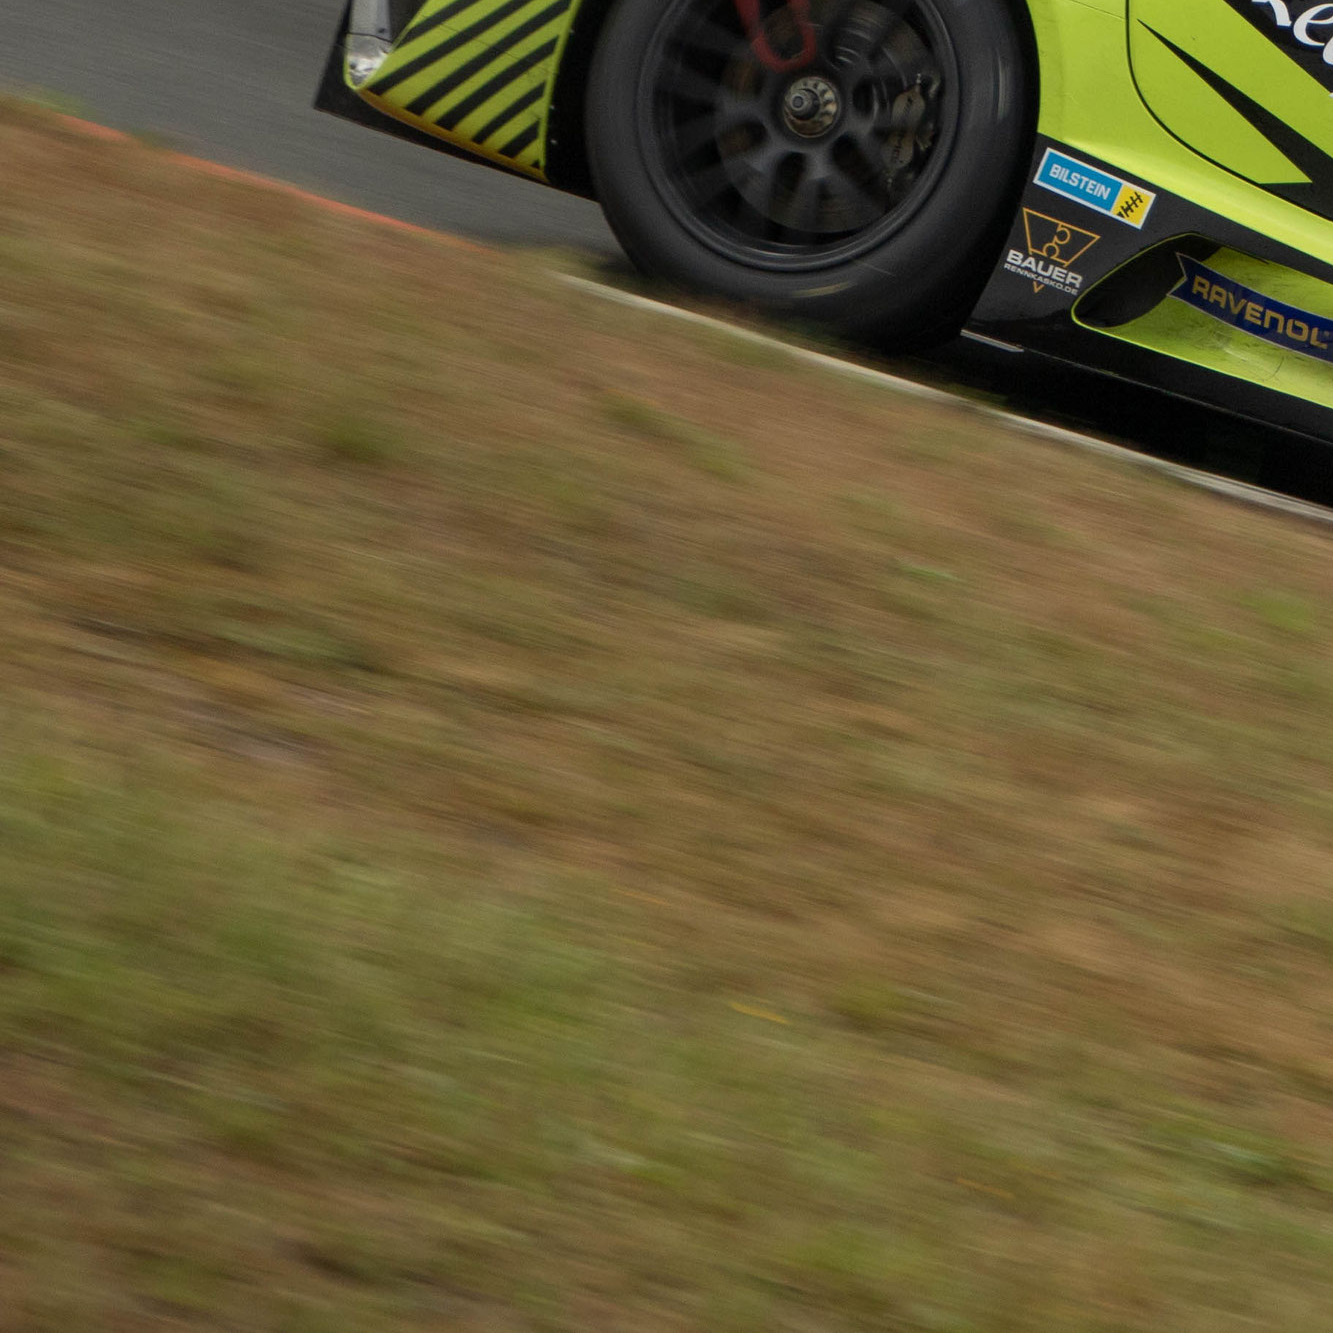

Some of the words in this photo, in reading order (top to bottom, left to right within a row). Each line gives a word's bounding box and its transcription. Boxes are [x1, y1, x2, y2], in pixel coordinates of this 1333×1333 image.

[1049, 163, 1111, 201] BILSTEIN
[1003, 262, 1080, 297] RENNKASKO.DE
[1006, 249, 1083, 289] BAUER
[1191, 274, 1329, 349] RAVENOL
